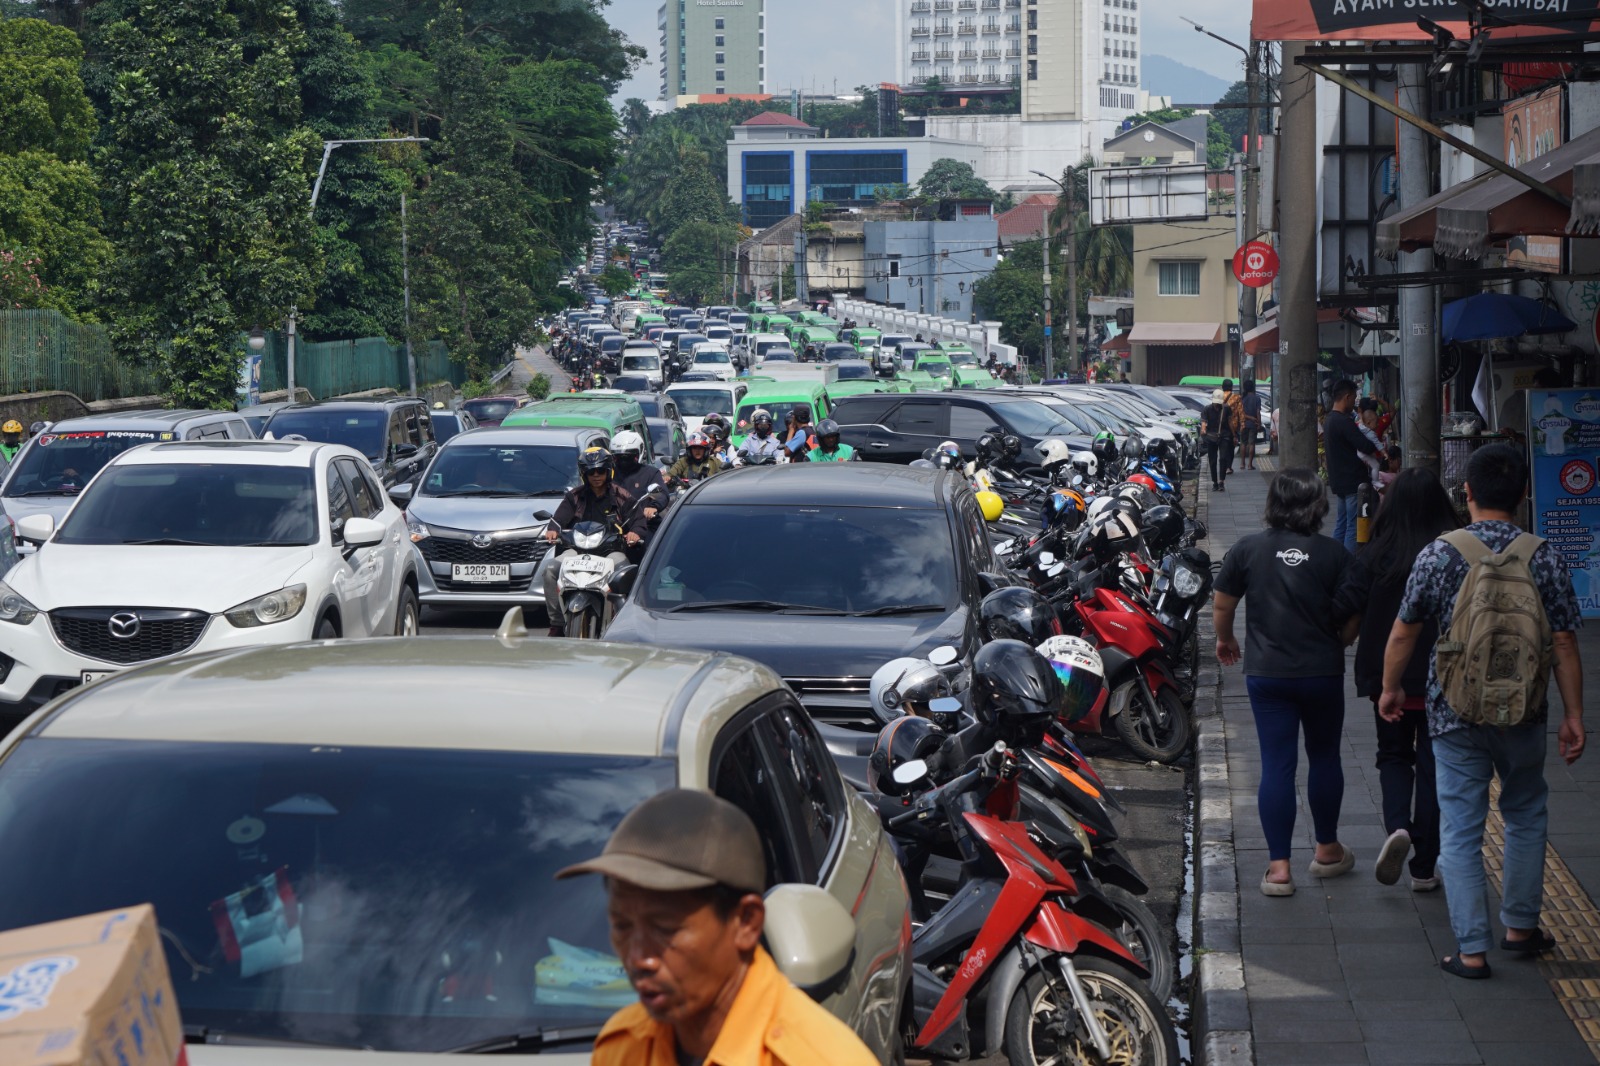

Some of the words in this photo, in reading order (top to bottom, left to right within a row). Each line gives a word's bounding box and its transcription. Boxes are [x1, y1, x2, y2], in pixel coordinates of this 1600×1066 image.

[1333, 0, 1394, 15] AYAM
[1404, 0, 1458, 9] SERE
[107, 431, 155, 439] INDONESIA
[1557, 498, 1582, 506] SEJAK
[1584, 497, 1600, 505] 1955
[455, 565, 461, 575] B
[464, 565, 487, 576] 1202
[490, 565, 507, 576] DZH
